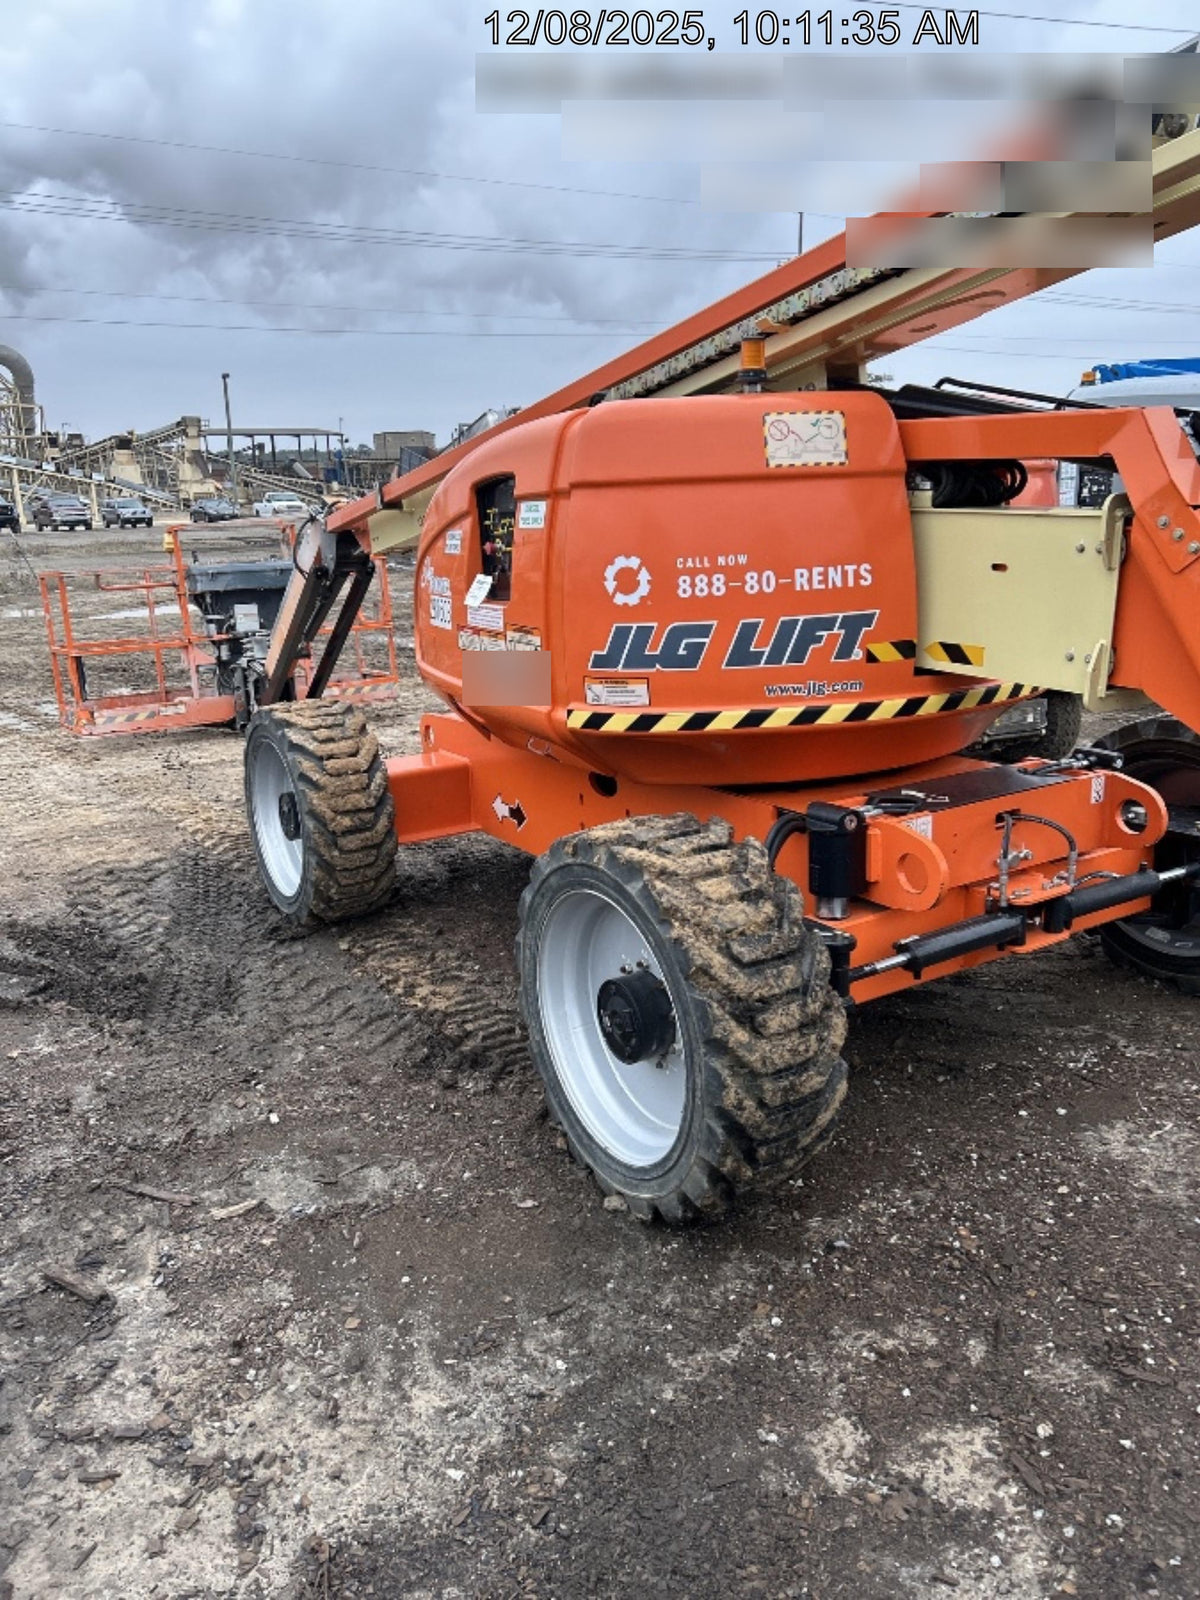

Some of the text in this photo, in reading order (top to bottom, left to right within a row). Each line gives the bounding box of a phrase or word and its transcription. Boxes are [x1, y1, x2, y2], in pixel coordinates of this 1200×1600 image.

[676, 554, 748, 569] CALL NOW
[676, 563, 873, 598] 888-80-RENTS
[588, 619, 719, 672] JLG
[721, 609, 881, 670] LIFT
[764, 680, 864, 698] www.jlg.com
